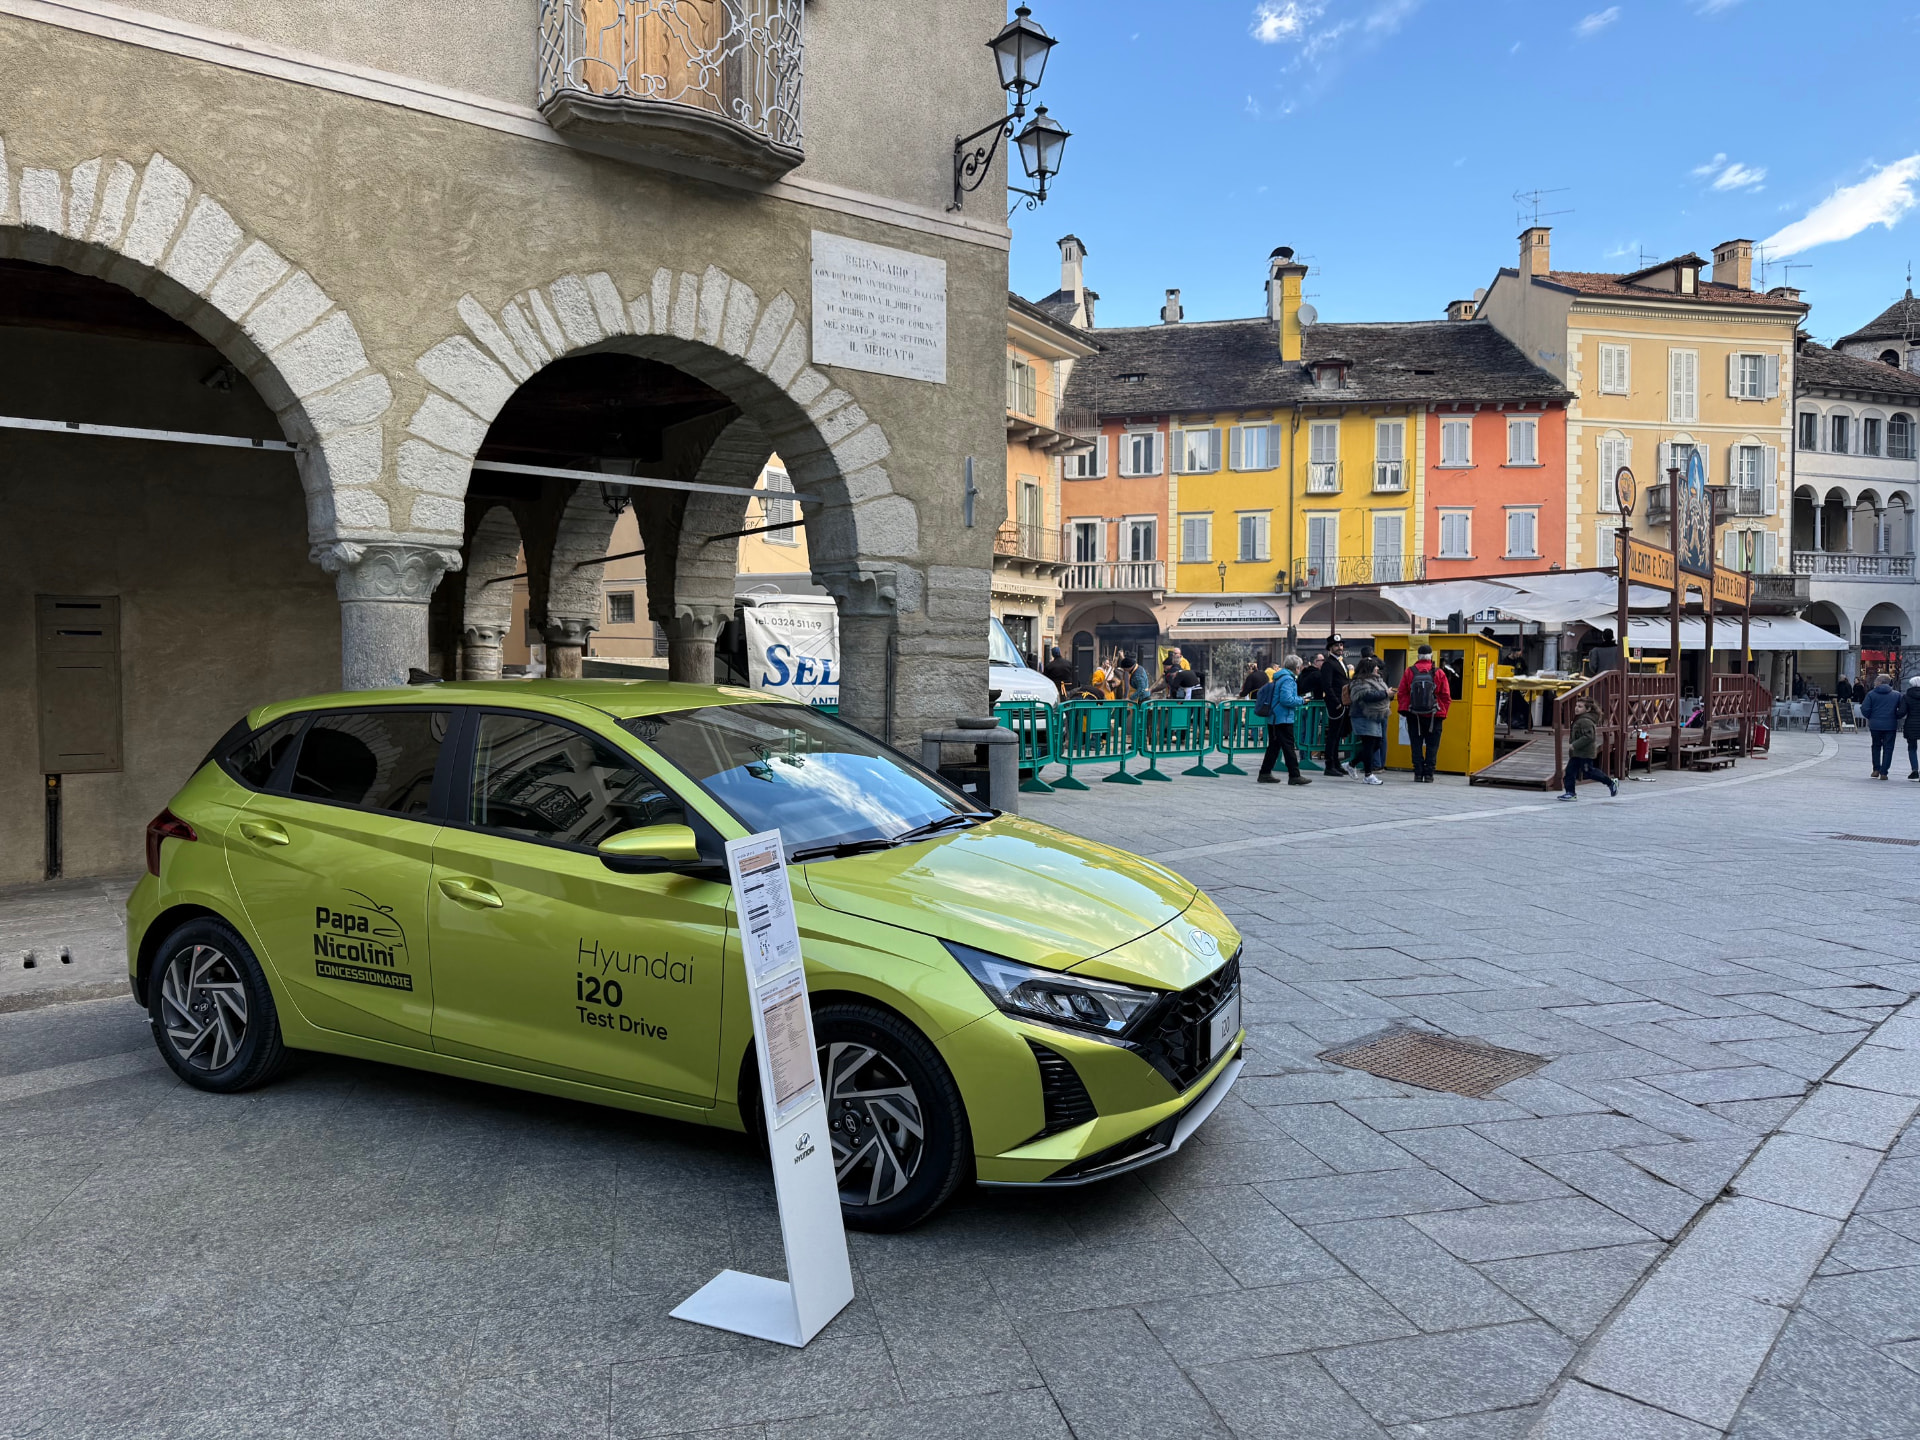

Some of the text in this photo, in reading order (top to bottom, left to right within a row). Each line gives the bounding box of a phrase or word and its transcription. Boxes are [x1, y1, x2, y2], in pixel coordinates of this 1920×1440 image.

[864, 342, 914, 361] MERCATO
[755, 617, 822, 630] tel. 0324 51149
[1184, 609, 1274, 618] GELATERIA
[316, 906, 369, 934] Papa
[313, 933, 395, 967] Nicolini
[578, 937, 694, 985] Hyundai
[317, 963, 411, 988] CONCESSIONARIE
[577, 971, 623, 1008] i20
[576, 1005, 668, 1040] Test Drive
[794, 1145, 815, 1165] HYUNDAI
